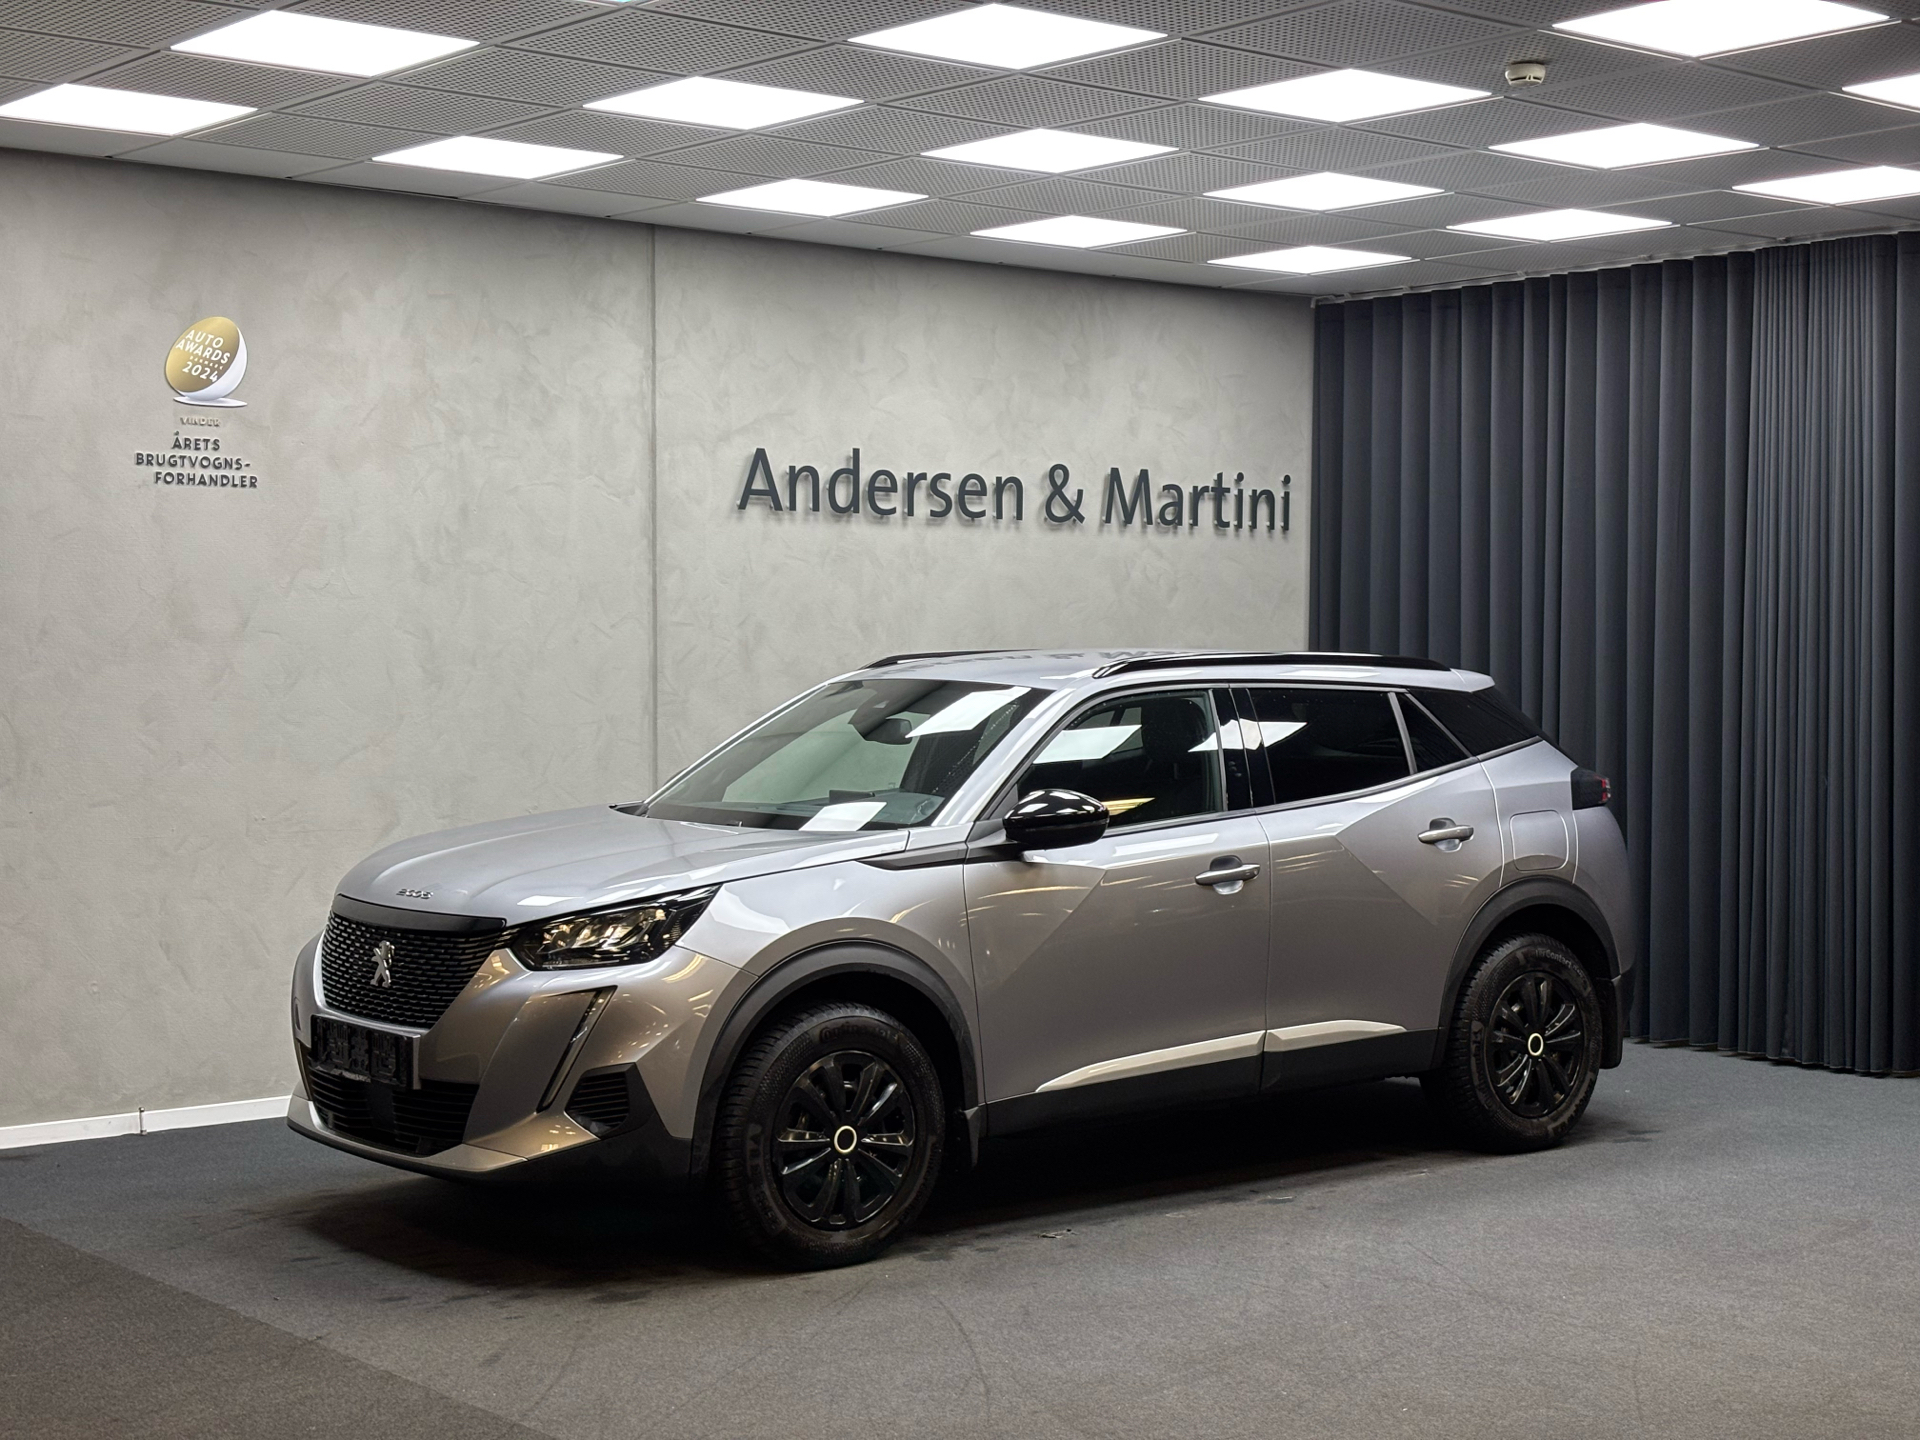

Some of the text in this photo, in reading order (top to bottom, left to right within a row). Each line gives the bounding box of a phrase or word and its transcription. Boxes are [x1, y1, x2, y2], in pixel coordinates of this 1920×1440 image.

[186, 329, 224, 348] AUTO
[176, 339, 231, 364] AWARDS
[182, 361, 218, 383] 2024
[180, 416, 221, 427] VINDER
[172, 430, 221, 451] ÅRETS
[135, 452, 251, 470] BRUGTVOGNS-
[154, 471, 258, 488] FORHANDLER
[738, 447, 1291, 532] Andersen & Martini
